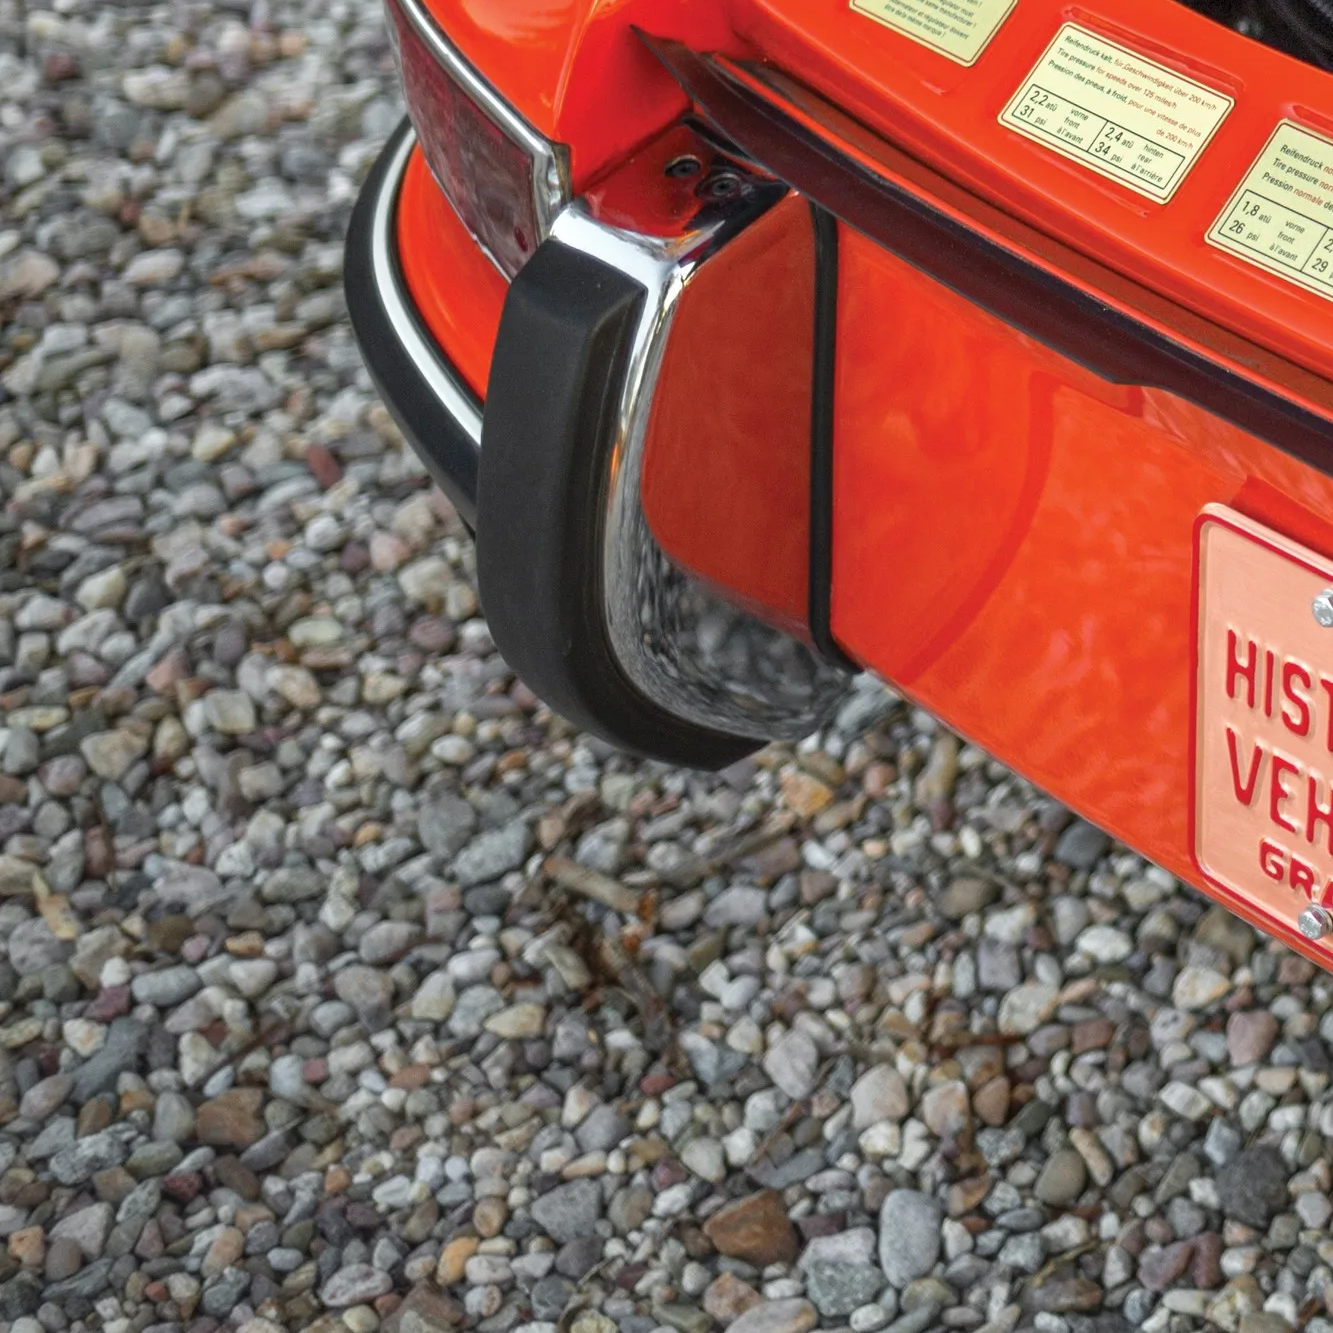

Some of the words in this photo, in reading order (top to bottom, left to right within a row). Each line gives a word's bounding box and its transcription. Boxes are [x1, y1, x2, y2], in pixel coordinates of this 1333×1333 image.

[1057, 47, 1069, 57] Tire
[1068, 55, 1095, 70] pressure
[1096, 66, 1105, 74] for
[1105, 72, 1127, 85] speeds
[1127, 83, 1142, 91] over
[1143, 88, 1155, 98] 125
[1065, 35, 1099, 56] Reifendruck
[1100, 53, 1112, 63] kalt,
[1114, 58, 1123, 66] für
[1173, 88, 1188, 97] über
[1188, 94, 1201, 103] 200
[1201, 100, 1216, 110] km/h
[1029, 90, 1048, 106] 2,2
[1048, 59, 1073, 75] Pression
[1073, 73, 1085, 82] des
[1127, 99, 1143, 109] pour
[1143, 107, 1156, 115] une
[1157, 113, 1178, 126] vitesse
[1186, 127, 1201, 137] plus
[1019, 104, 1034, 118] 31
[1034, 116, 1047, 125] psi
[1064, 116, 1080, 129] front
[1070, 109, 1088, 120] vorne
[1104, 126, 1123, 142] 2,4
[1165, 132, 1177, 142] 200
[1177, 138, 1193, 148] km/h
[1094, 141, 1111, 155] 34
[1110, 154, 1122, 162] psi
[1137, 154, 1152, 163] rear
[1143, 144, 1163, 158] hinten
[1280, 144, 1323, 169] Reifendruck
[1273, 157, 1286, 170] Tire
[1285, 166, 1318, 184] pressure
[1262, 172, 1293, 191] Pression
[1293, 188, 1323, 205] normale
[1242, 201, 1260, 216] 1,8
[1229, 219, 1245, 234] 26
[1246, 232, 1260, 241] psi
[1285, 221, 1304, 233] vorne
[1277, 231, 1294, 244] front
[1311, 257, 1328, 272] 29
